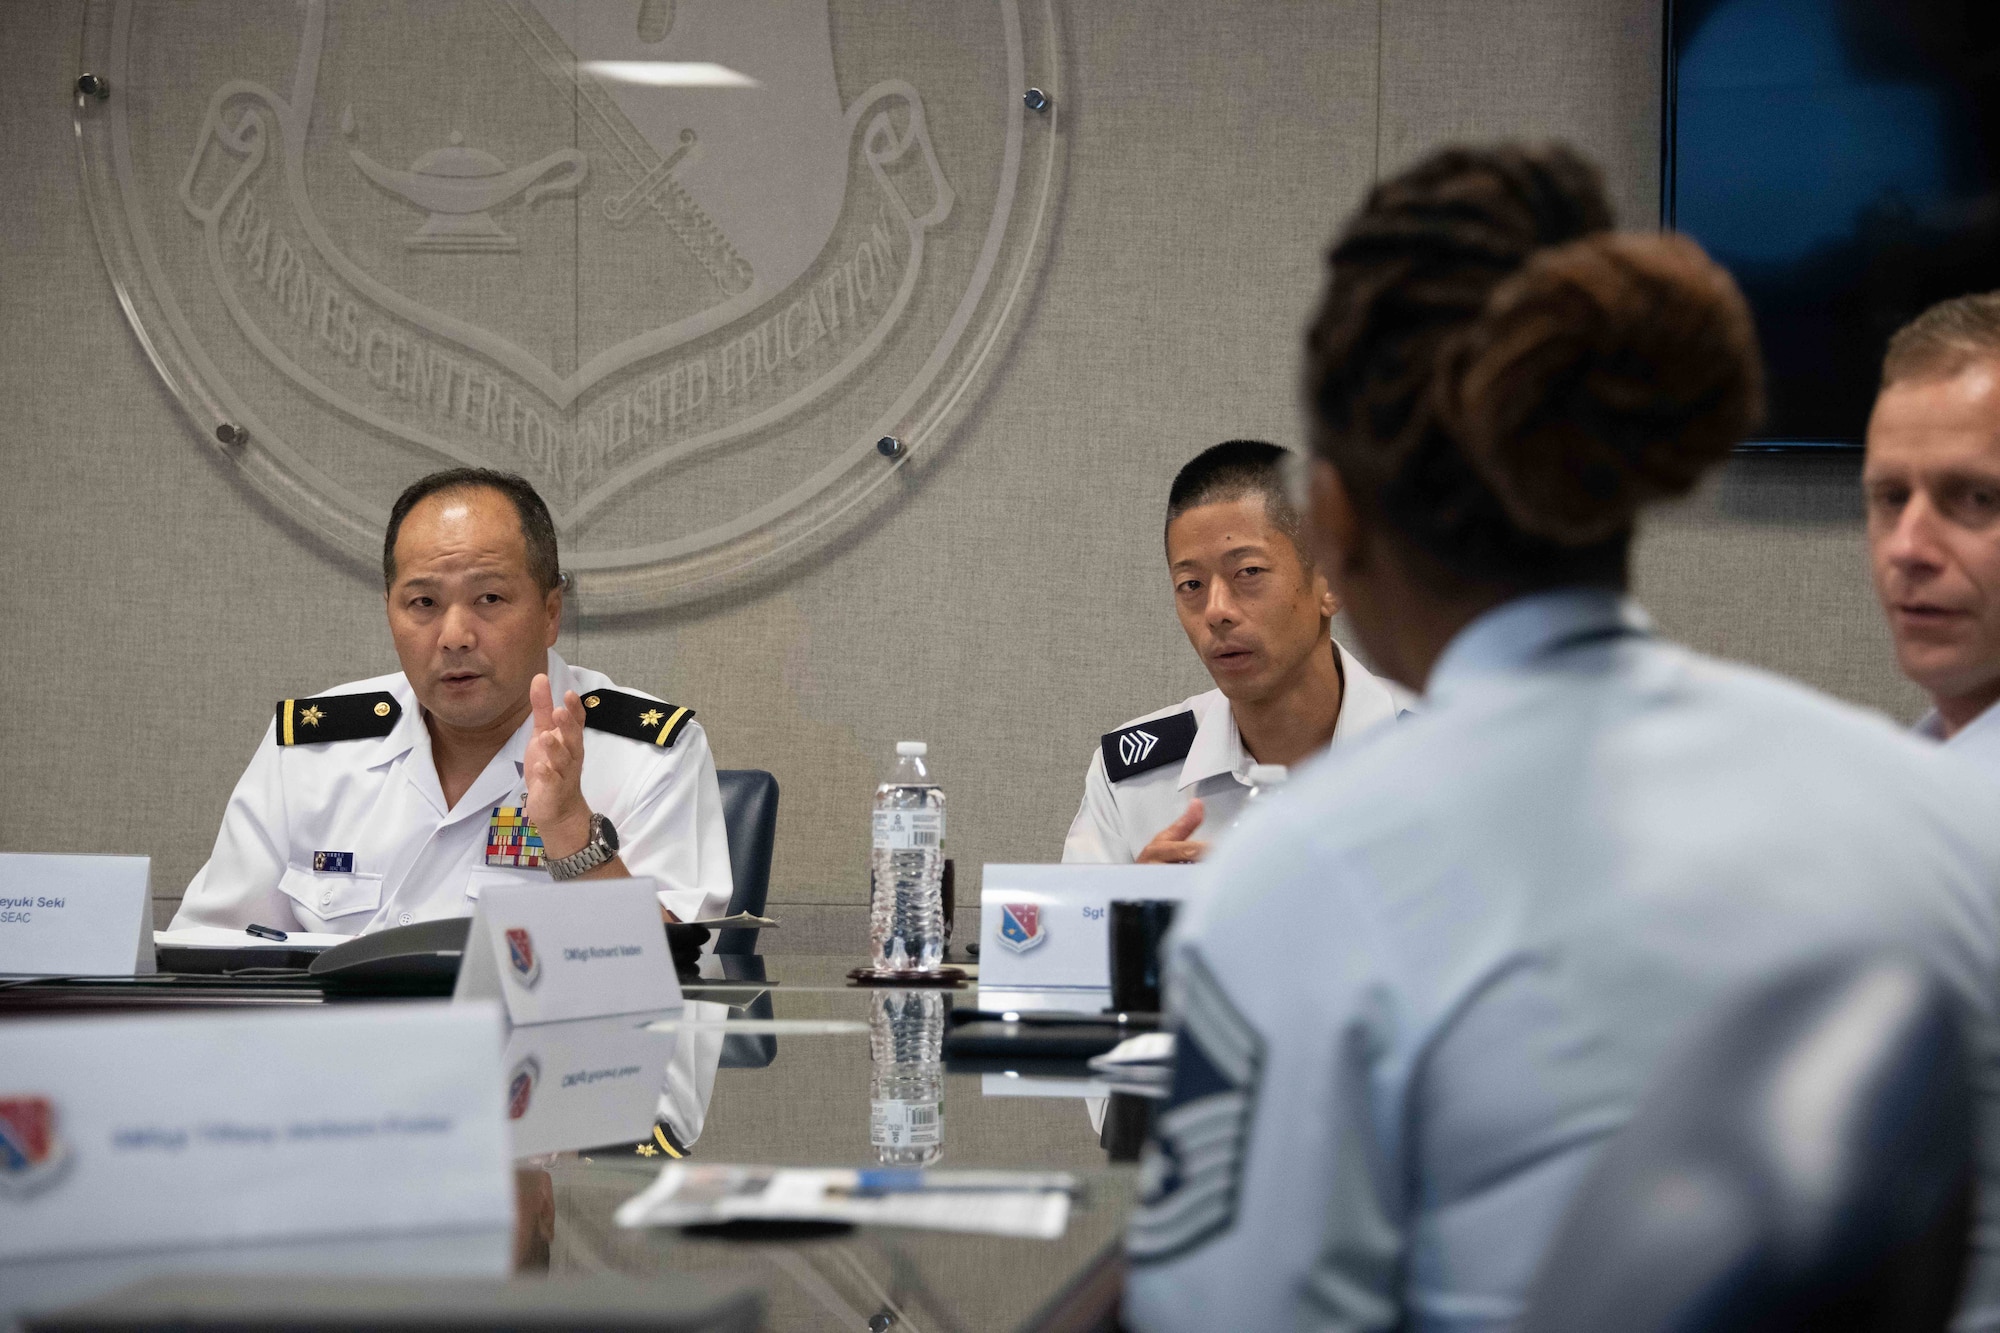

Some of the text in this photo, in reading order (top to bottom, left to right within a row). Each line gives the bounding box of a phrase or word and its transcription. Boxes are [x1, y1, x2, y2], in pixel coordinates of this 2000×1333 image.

[234, 186, 895, 484] BARNES CENTER FOR ENLISTED EDUCATION
[0, 897, 65, 909] eyuki Seki
[0, 912, 31, 923] SEAC
[1082, 907, 1105, 920] Sgt
